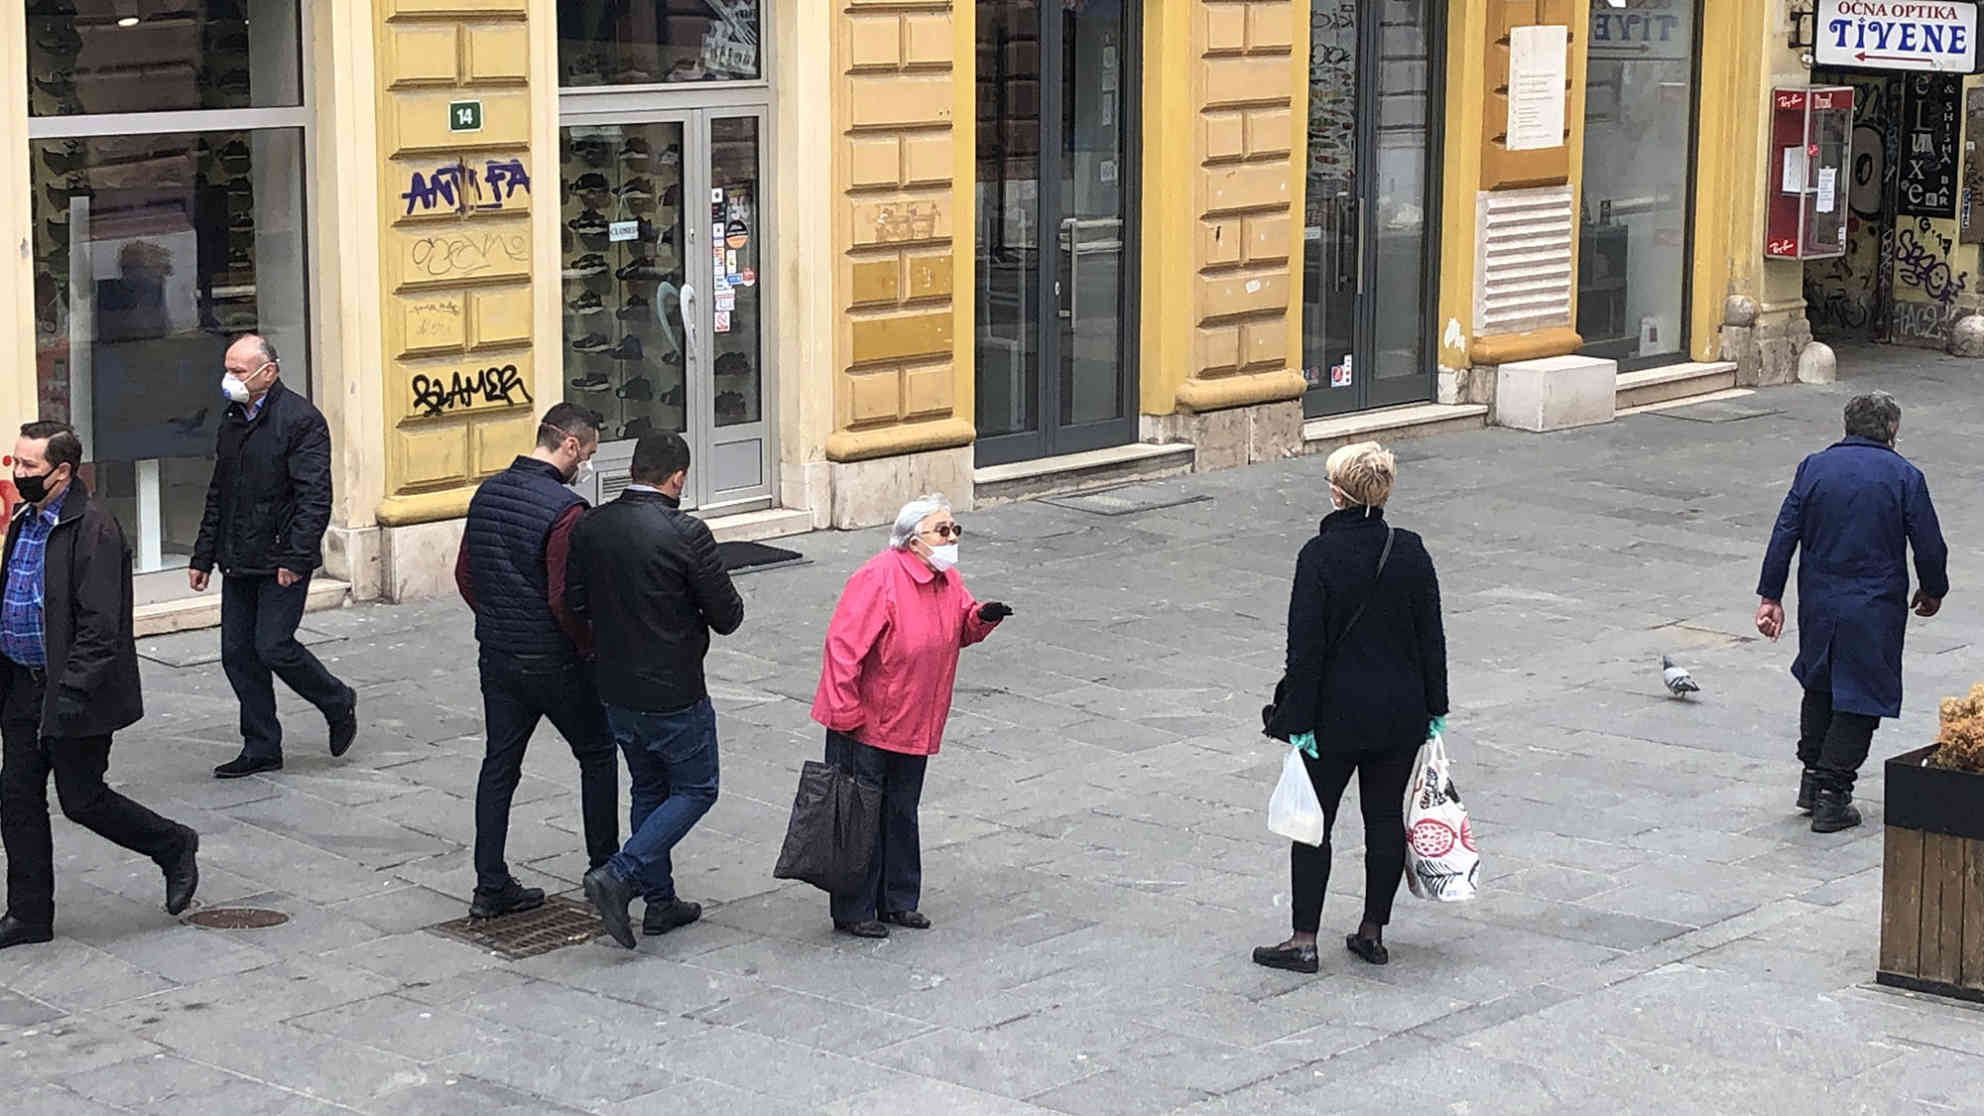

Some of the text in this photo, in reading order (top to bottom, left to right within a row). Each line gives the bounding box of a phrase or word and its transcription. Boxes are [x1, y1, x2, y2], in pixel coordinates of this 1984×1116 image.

[1891, 4, 1958, 19] OPTIKA
[456, 108, 473, 125] 14
[1938, 175, 1950, 206] BAR
